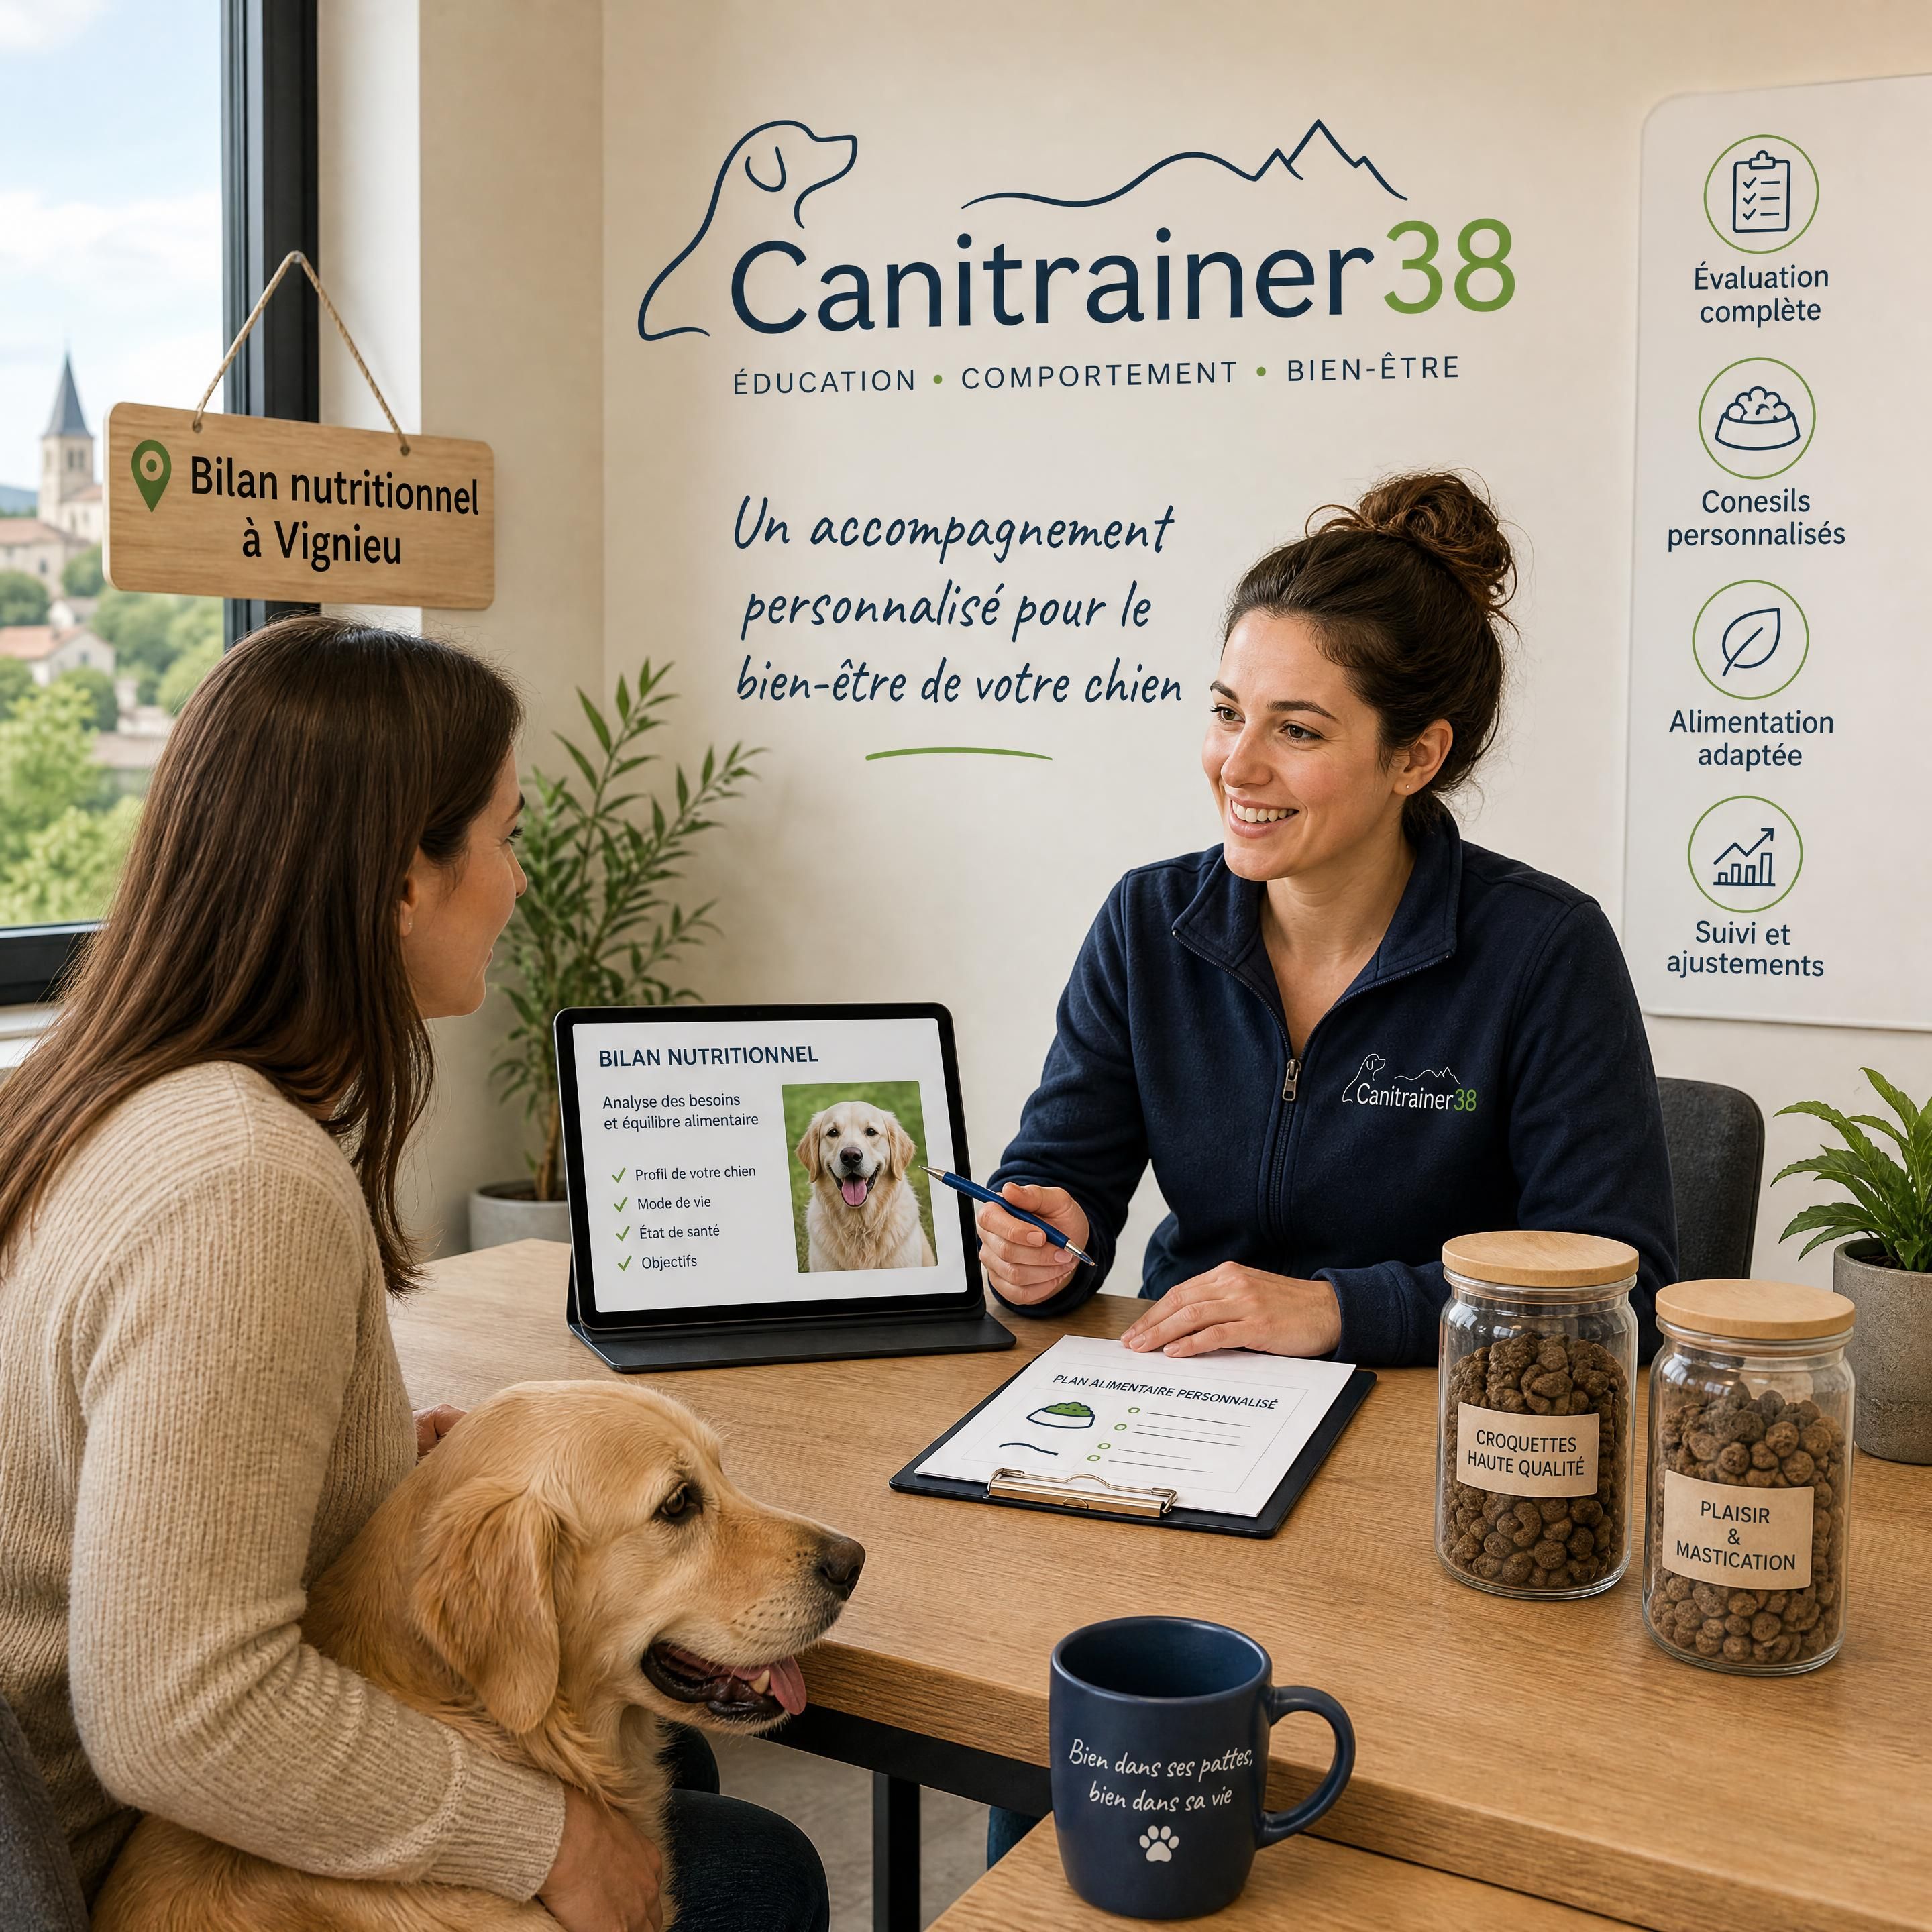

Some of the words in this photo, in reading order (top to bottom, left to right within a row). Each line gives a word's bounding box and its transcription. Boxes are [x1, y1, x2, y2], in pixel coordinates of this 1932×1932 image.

[731, 218, 1515, 334] Canitrainer38
[1695, 261, 1828, 290] Évaluation
[1701, 297, 1821, 328] complète
[735, 368, 913, 394] ÉDUCATION
[962, 362, 1236, 389] COMPORTEMENT
[1289, 352, 1458, 381] BIEN-ÊTRE
[192, 456, 277, 500] Bilan
[292, 469, 478, 515] nutritionnel
[1703, 488, 1810, 513] Conesils
[735, 496, 790, 549] Un
[810, 505, 1175, 564] accompagnement
[1668, 521, 1845, 552] personnalisés
[243, 517, 261, 557] à
[274, 521, 400, 572] Vignieu
[741, 579, 1004, 641] personnalisé
[1012, 596, 1106, 643] pour
[1122, 580, 1151, 627] le
[737, 655, 906, 702] bien-être
[921, 657, 961, 703] de
[977, 667, 1069, 703] votre
[1085, 657, 1181, 703] chien
[1669, 710, 1833, 733] Alimentation
[1699, 743, 1802, 771] adaptée
[1696, 920, 1756, 944] Suivi
[1766, 924, 1790, 945] et
[1668, 950, 1823, 978] ajustements
[600, 1049, 660, 1067] BILAN
[668, 1046, 818, 1065] NUTRITIONNEL
[603, 1095, 657, 1111] Analyse
[661, 1095, 685, 1107] des
[690, 1093, 740, 1106] besoins
[1357, 1083, 1476, 1111] Canitrainer38
[604, 1118, 618, 1129] et
[623, 1116, 680, 1132] équilibre
[685, 1114, 758, 1127] alimentaire
[636, 1168, 667, 1181] Profil
[672, 1168, 686, 1179] de
[690, 1168, 720, 1178] votre
[724, 1166, 755, 1177] chien
[638, 1197, 672, 1209] Mode
[676, 1197, 690, 1208] de
[694, 1196, 710, 1207] vie
[640, 1225, 665, 1239] État
[669, 1226, 683, 1238] de
[688, 1224, 719, 1236] santé
[642, 1255, 697, 1271] Objectifs
[1053, 1375, 1089, 1386] PLAN
[1089, 1379, 1175, 1396] ALIMENTAIRE
[1177, 1390, 1278, 1409] PERSONNALISÉ
[1475, 1430, 1576, 1454] CROQUETTES
[1468, 1450, 1513, 1473] HAUTE
[1519, 1456, 1584, 1477] QUALITÉ
[1701, 1501, 1769, 1523] PLAISIR
[1728, 1529, 1740, 1545] &
[1676, 1540, 1795, 1570] MASTICATION
[1069, 1739, 1108, 1769] Bien
[1115, 1752, 1161, 1777] dans
[1167, 1761, 1195, 1777] ses
[1199, 1748, 1252, 1782] pattes,
[1089, 1780, 1126, 1807] bien
[1133, 1789, 1179, 1811] dans
[1185, 1796, 1205, 1811] sa
[1212, 1786, 1232, 1805] vie
